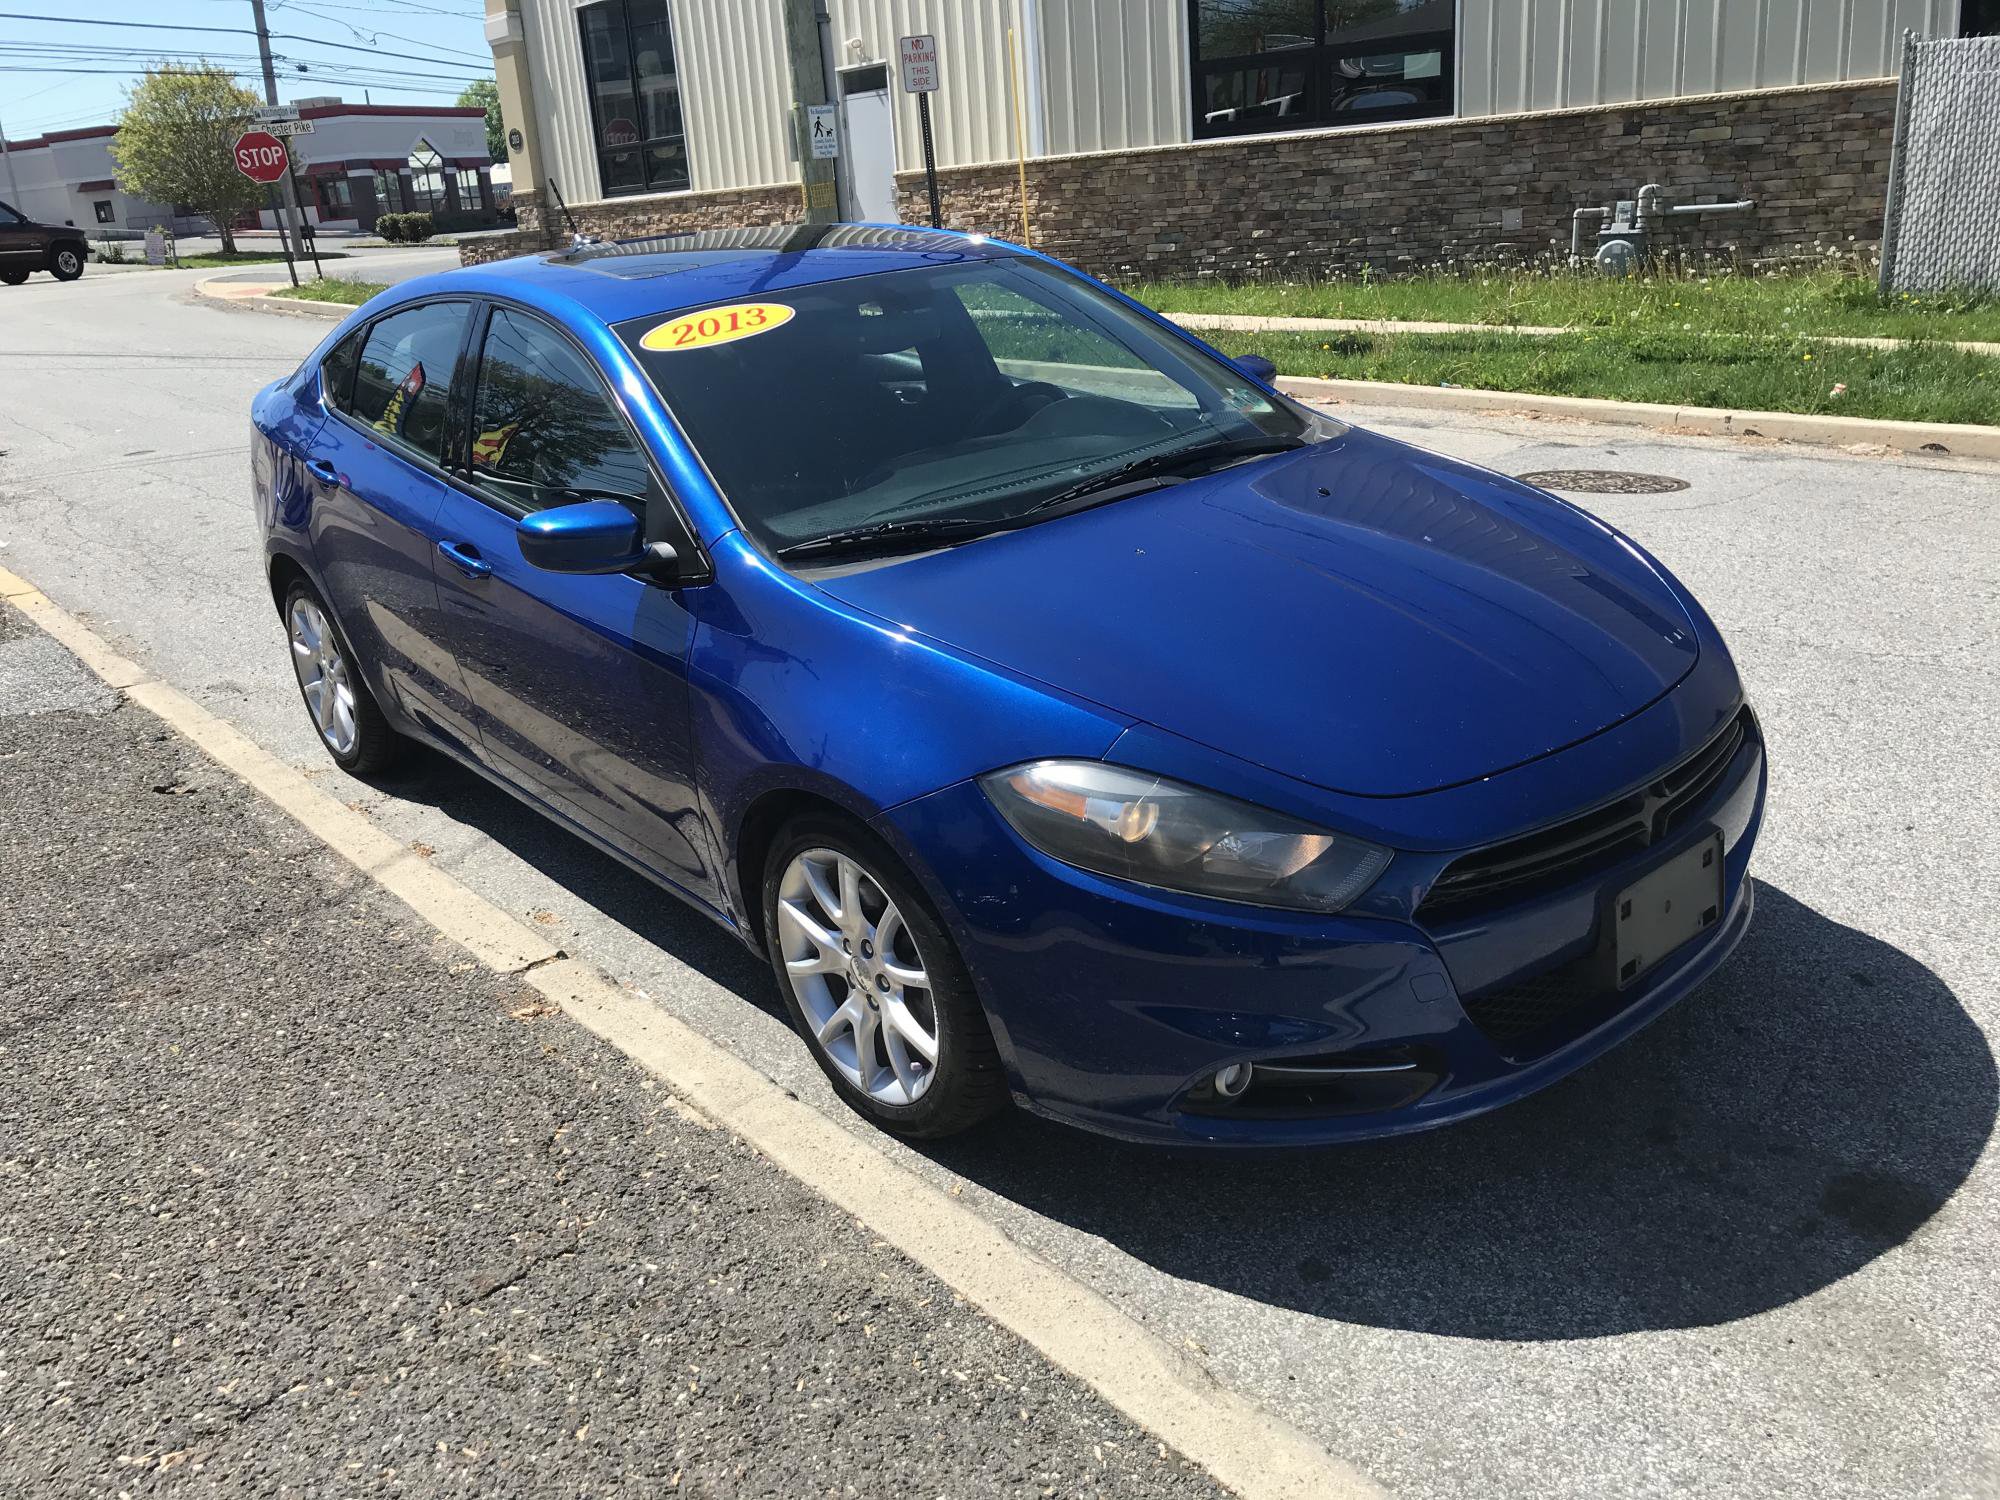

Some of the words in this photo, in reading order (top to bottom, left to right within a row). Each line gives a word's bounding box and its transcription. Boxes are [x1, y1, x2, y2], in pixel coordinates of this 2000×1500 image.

[912, 39, 924, 50] NO
[904, 52, 935, 64] PARKING
[912, 66, 929, 75] THIS
[913, 77, 930, 86] SIDE
[294, 122, 311, 133] Pike
[239, 146, 282, 168] STOP
[672, 308, 767, 345] 2013
